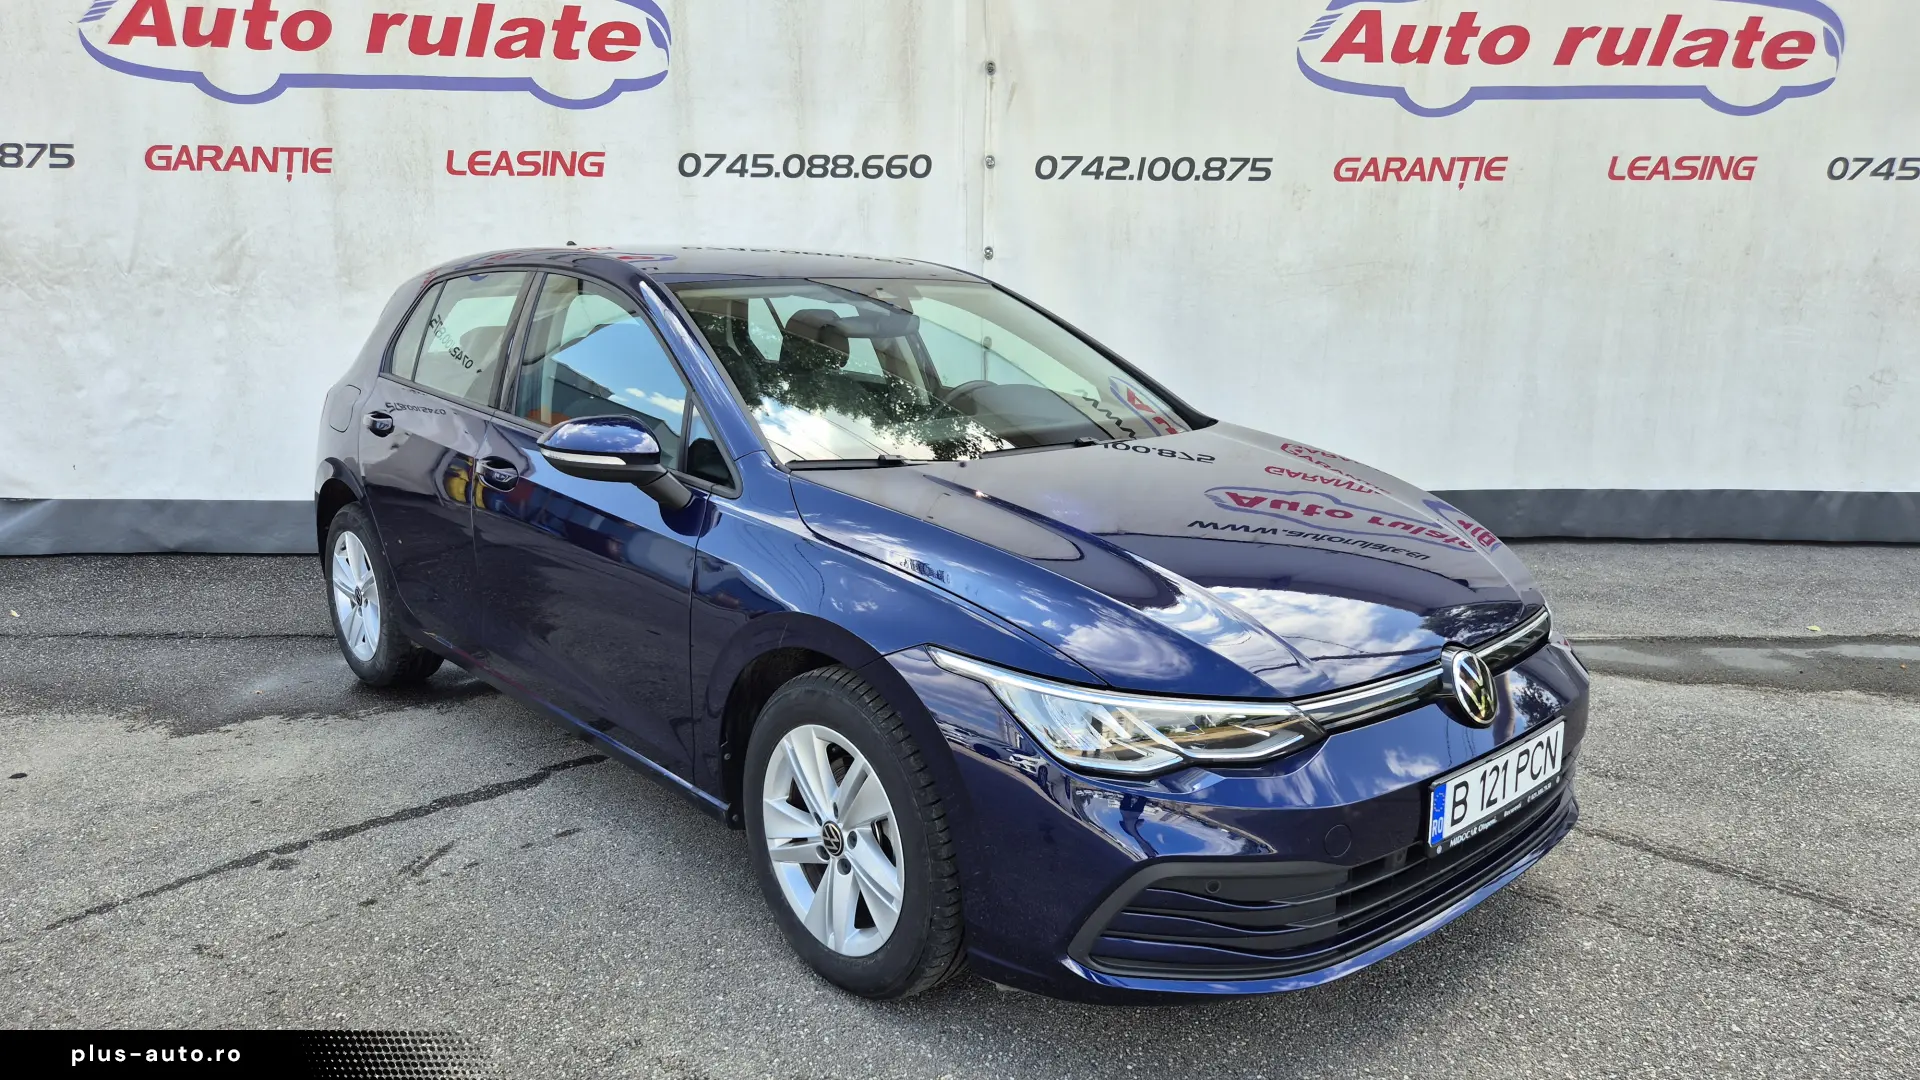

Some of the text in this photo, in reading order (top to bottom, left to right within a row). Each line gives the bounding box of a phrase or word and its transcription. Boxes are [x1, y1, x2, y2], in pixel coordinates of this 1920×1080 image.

[109, 0, 642, 62] Auto rulate
[1321, 9, 1817, 70] Auto rulate
[0, 142, 76, 169] 875
[446, 149, 606, 178] LEASING
[678, 152, 932, 180] 0745.088.660
[1034, 155, 1274, 182] 0742.100.875
[1607, 155, 1758, 182] LEASING
[1451, 731, 1559, 827] B 121 PCN
[1431, 816, 1444, 837] RO
